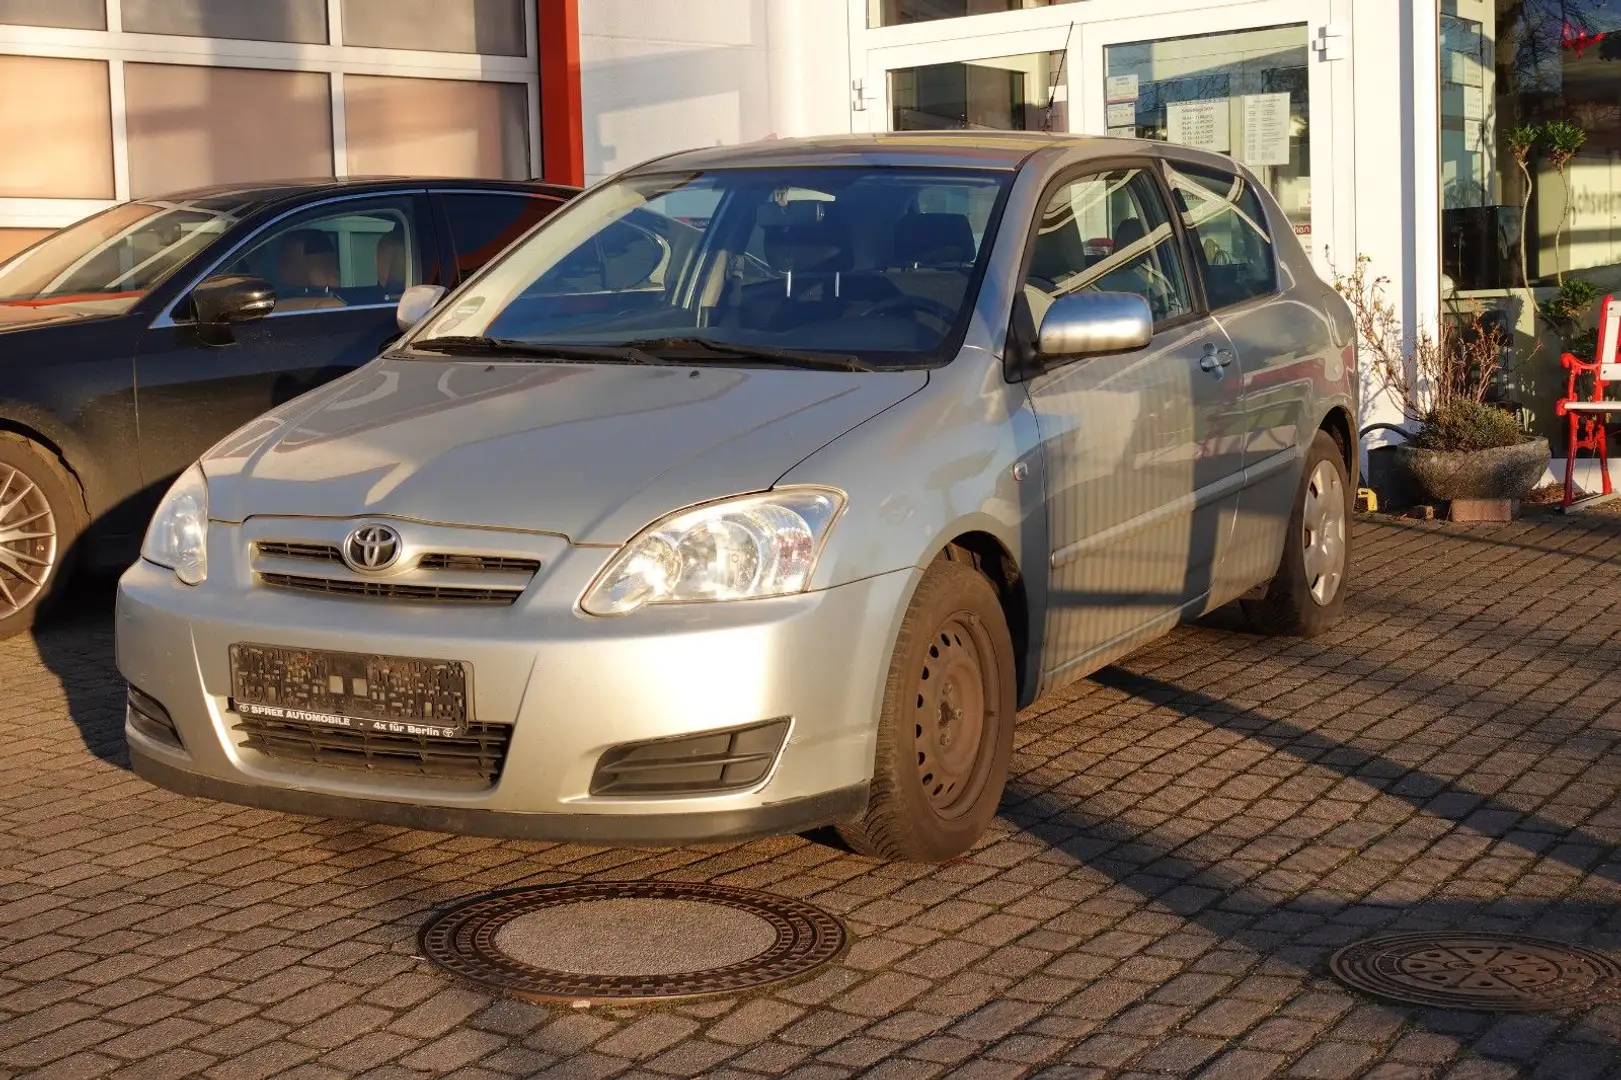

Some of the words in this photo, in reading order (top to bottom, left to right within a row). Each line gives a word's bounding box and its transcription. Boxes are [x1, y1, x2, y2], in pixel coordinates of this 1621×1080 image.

[251, 706, 284, 717] SPREE
[286, 710, 351, 726] AUTOMOBILE
[373, 722, 387, 731] 4x
[388, 723, 405, 732] für
[407, 725, 440, 736] Berlin
